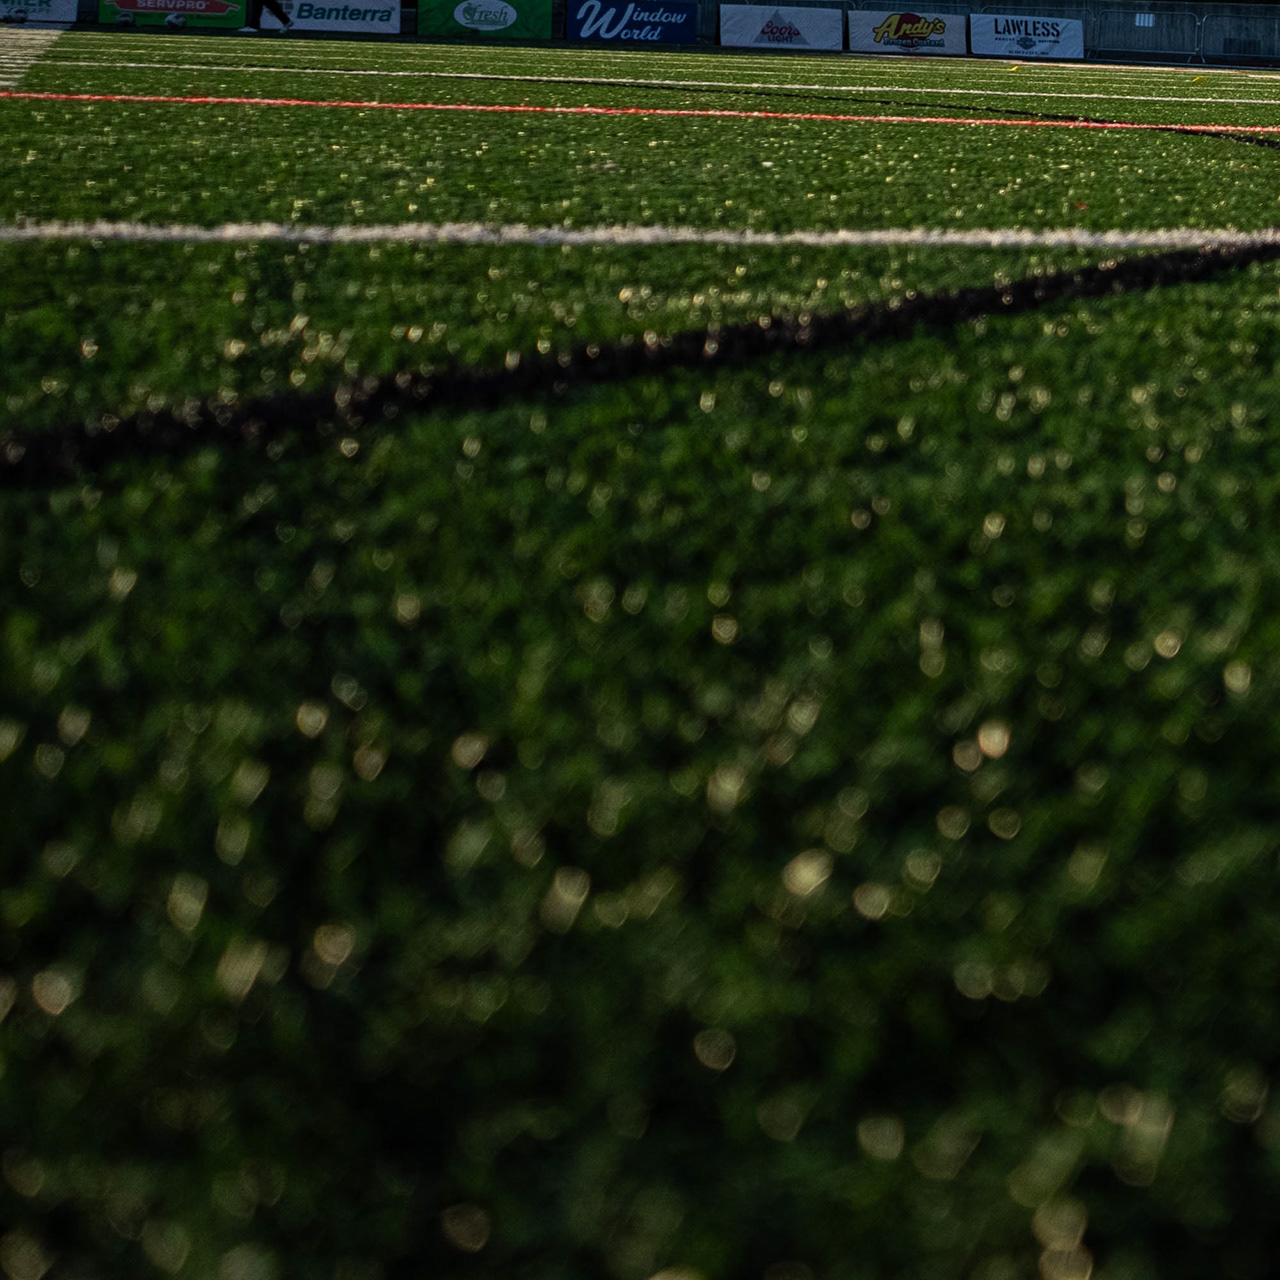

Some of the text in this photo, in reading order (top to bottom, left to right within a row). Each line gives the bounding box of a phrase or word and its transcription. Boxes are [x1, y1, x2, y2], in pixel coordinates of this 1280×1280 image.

[297, 3, 393, 23] Banterra
[472, 4, 508, 22] fresh
[576, 0, 687, 40] Window
[761, 20, 801, 36] Coors
[873, 13, 946, 42] Andy's
[994, 18, 1060, 37] LAWLESS
[768, 34, 794, 43] LIGHT
